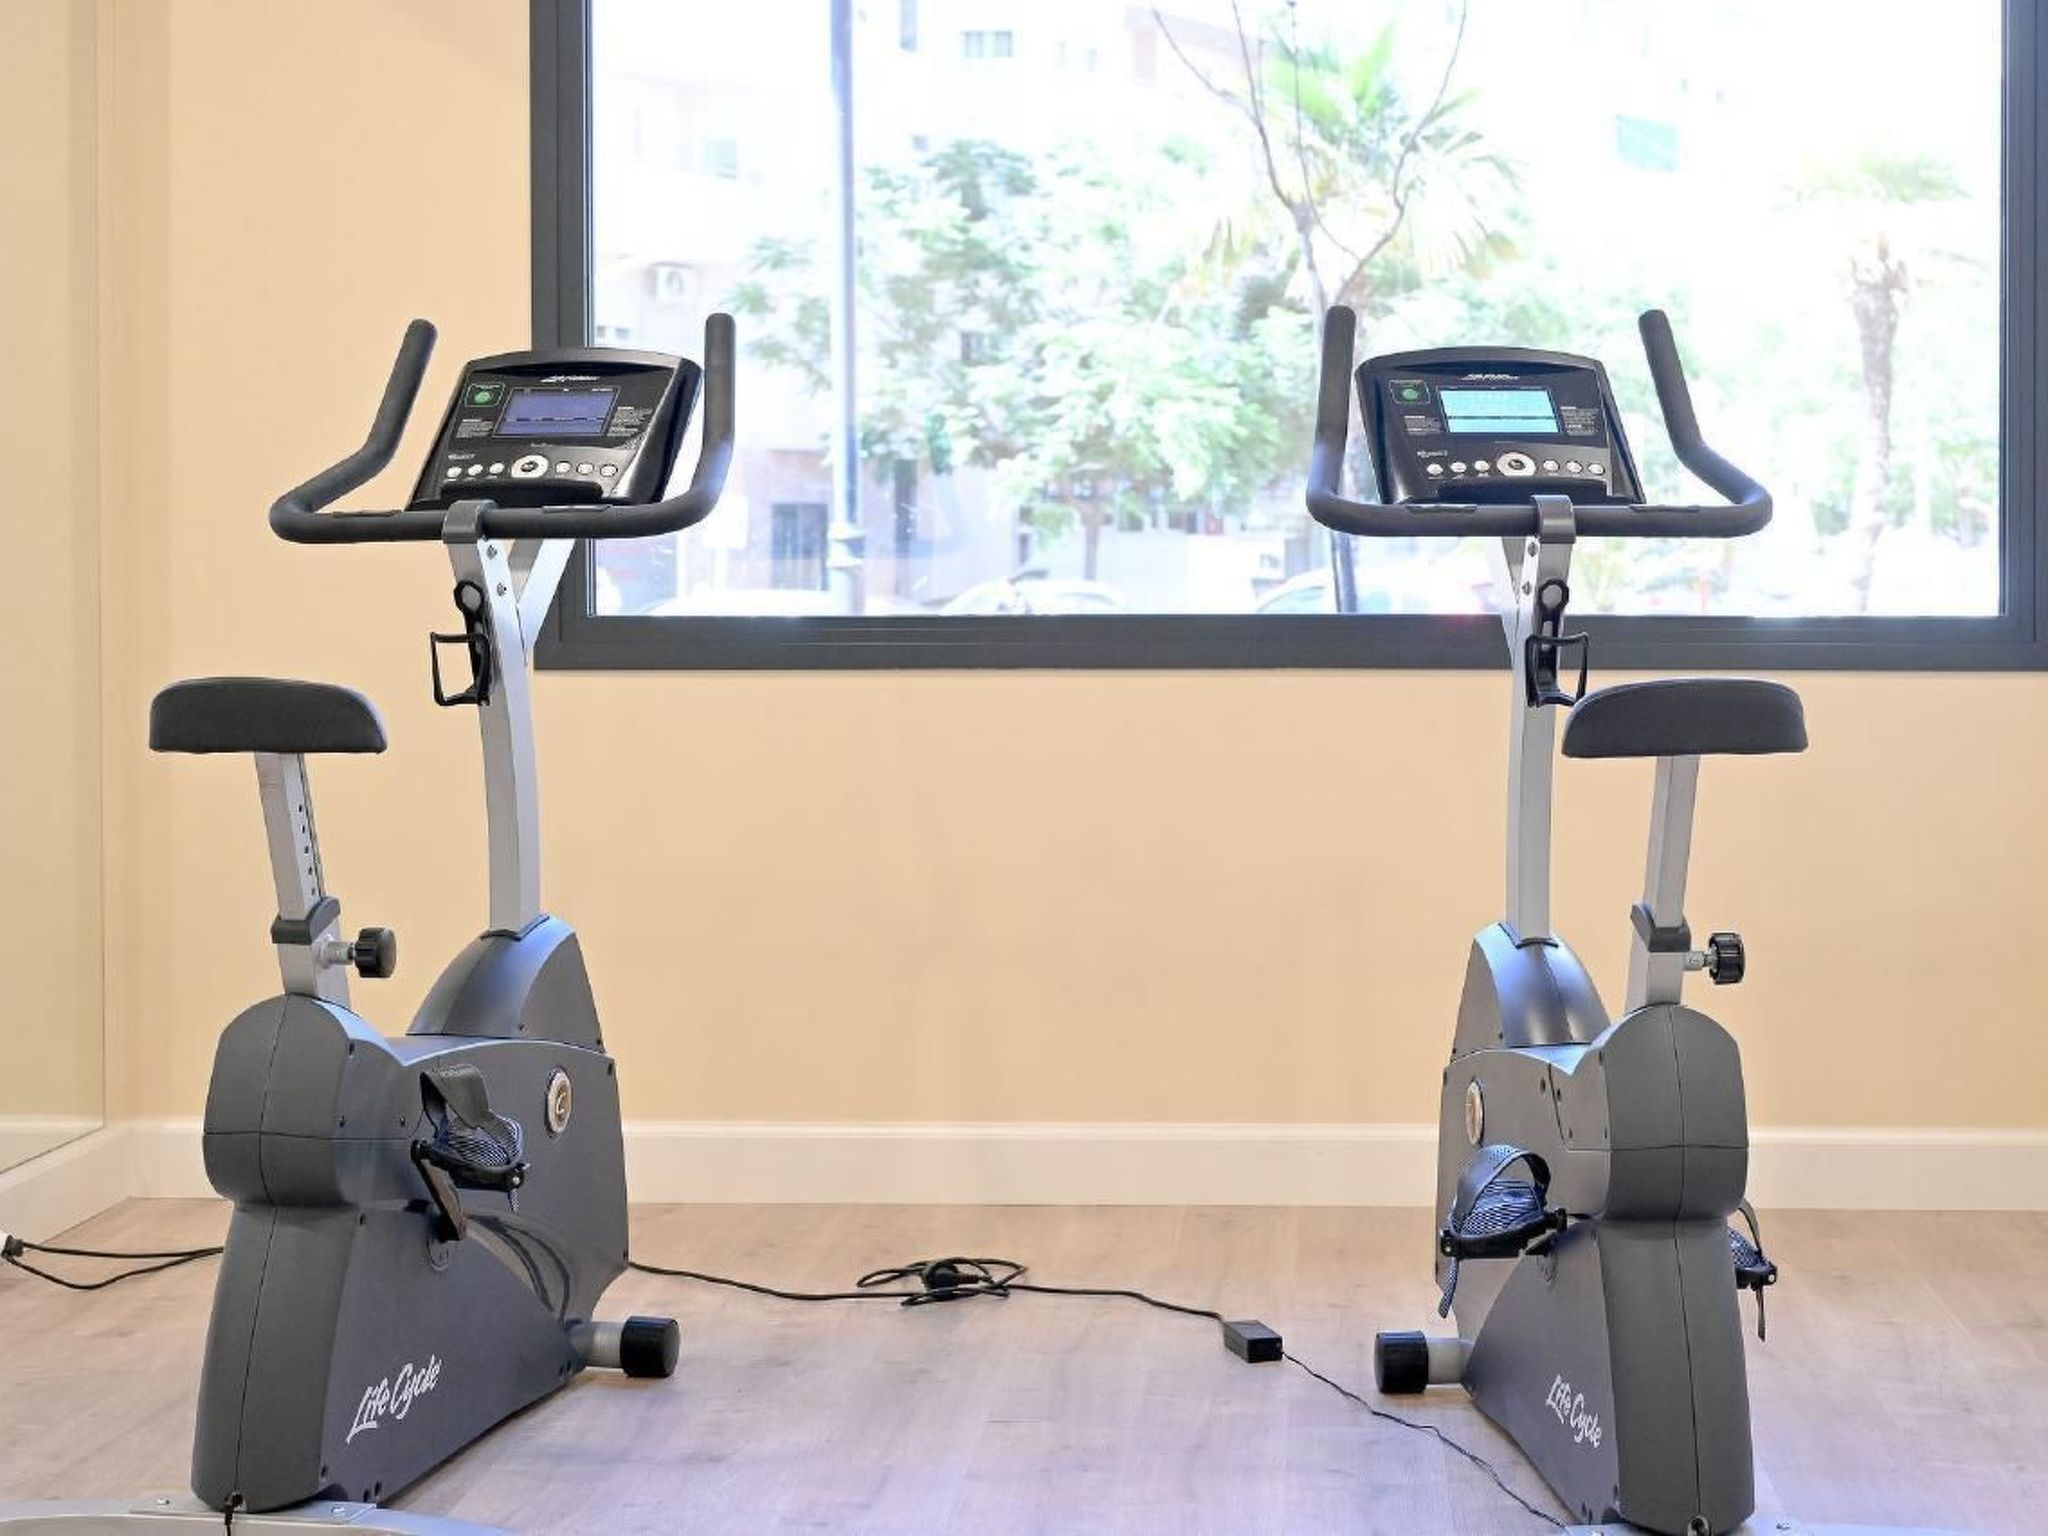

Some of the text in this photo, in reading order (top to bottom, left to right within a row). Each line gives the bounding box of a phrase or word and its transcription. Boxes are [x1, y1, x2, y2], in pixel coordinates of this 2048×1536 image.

[346, 1354, 442, 1445] Life Cycle
[1545, 1374, 1602, 1448] Life Cycle
